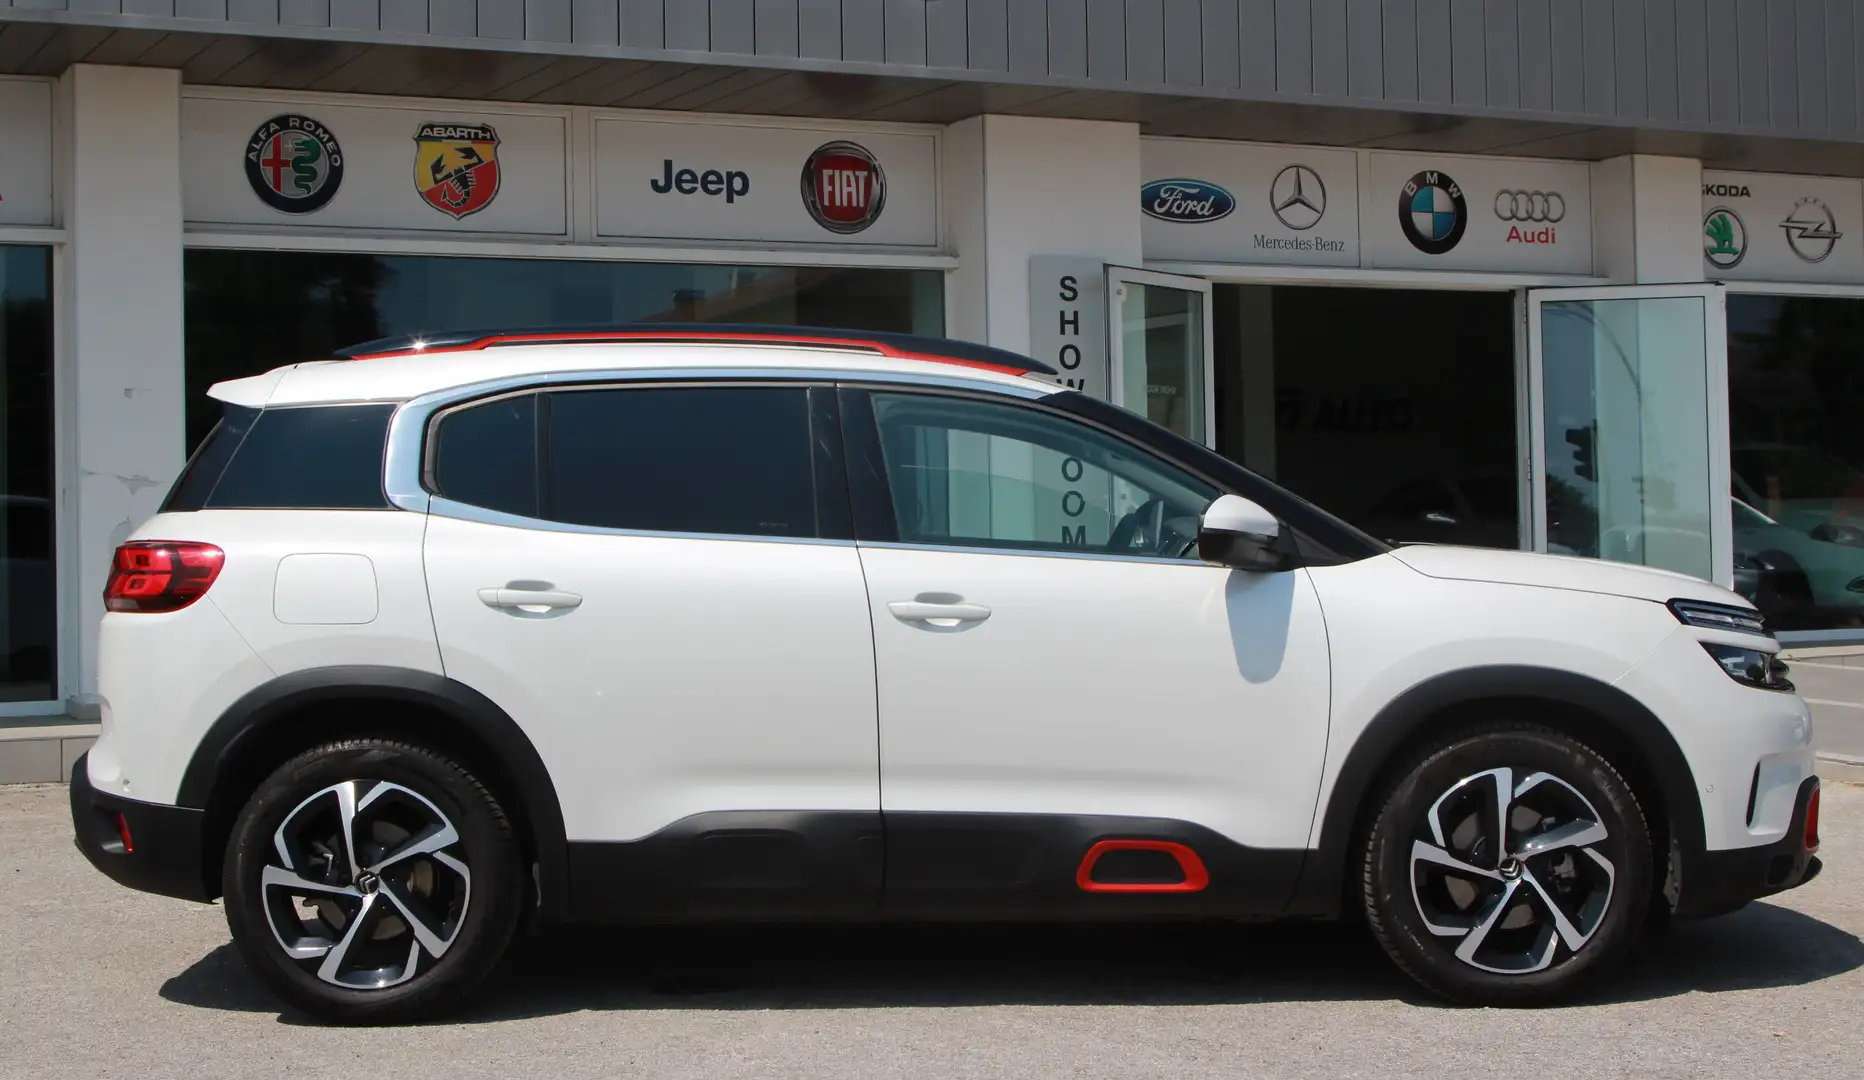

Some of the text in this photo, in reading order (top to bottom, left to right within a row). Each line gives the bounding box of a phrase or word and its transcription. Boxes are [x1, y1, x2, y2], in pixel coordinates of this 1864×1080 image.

[248, 117, 341, 167] ALFA ROMEO
[420, 127, 491, 140] ABARTH
[650, 159, 750, 204] Jeep
[822, 169, 868, 208] FIAT
[1404, 172, 1461, 199] BMW
[1153, 185, 1216, 216] Ford
[1253, 234, 1345, 252] Mercedes-Benz
[1506, 225, 1556, 244] Audi
